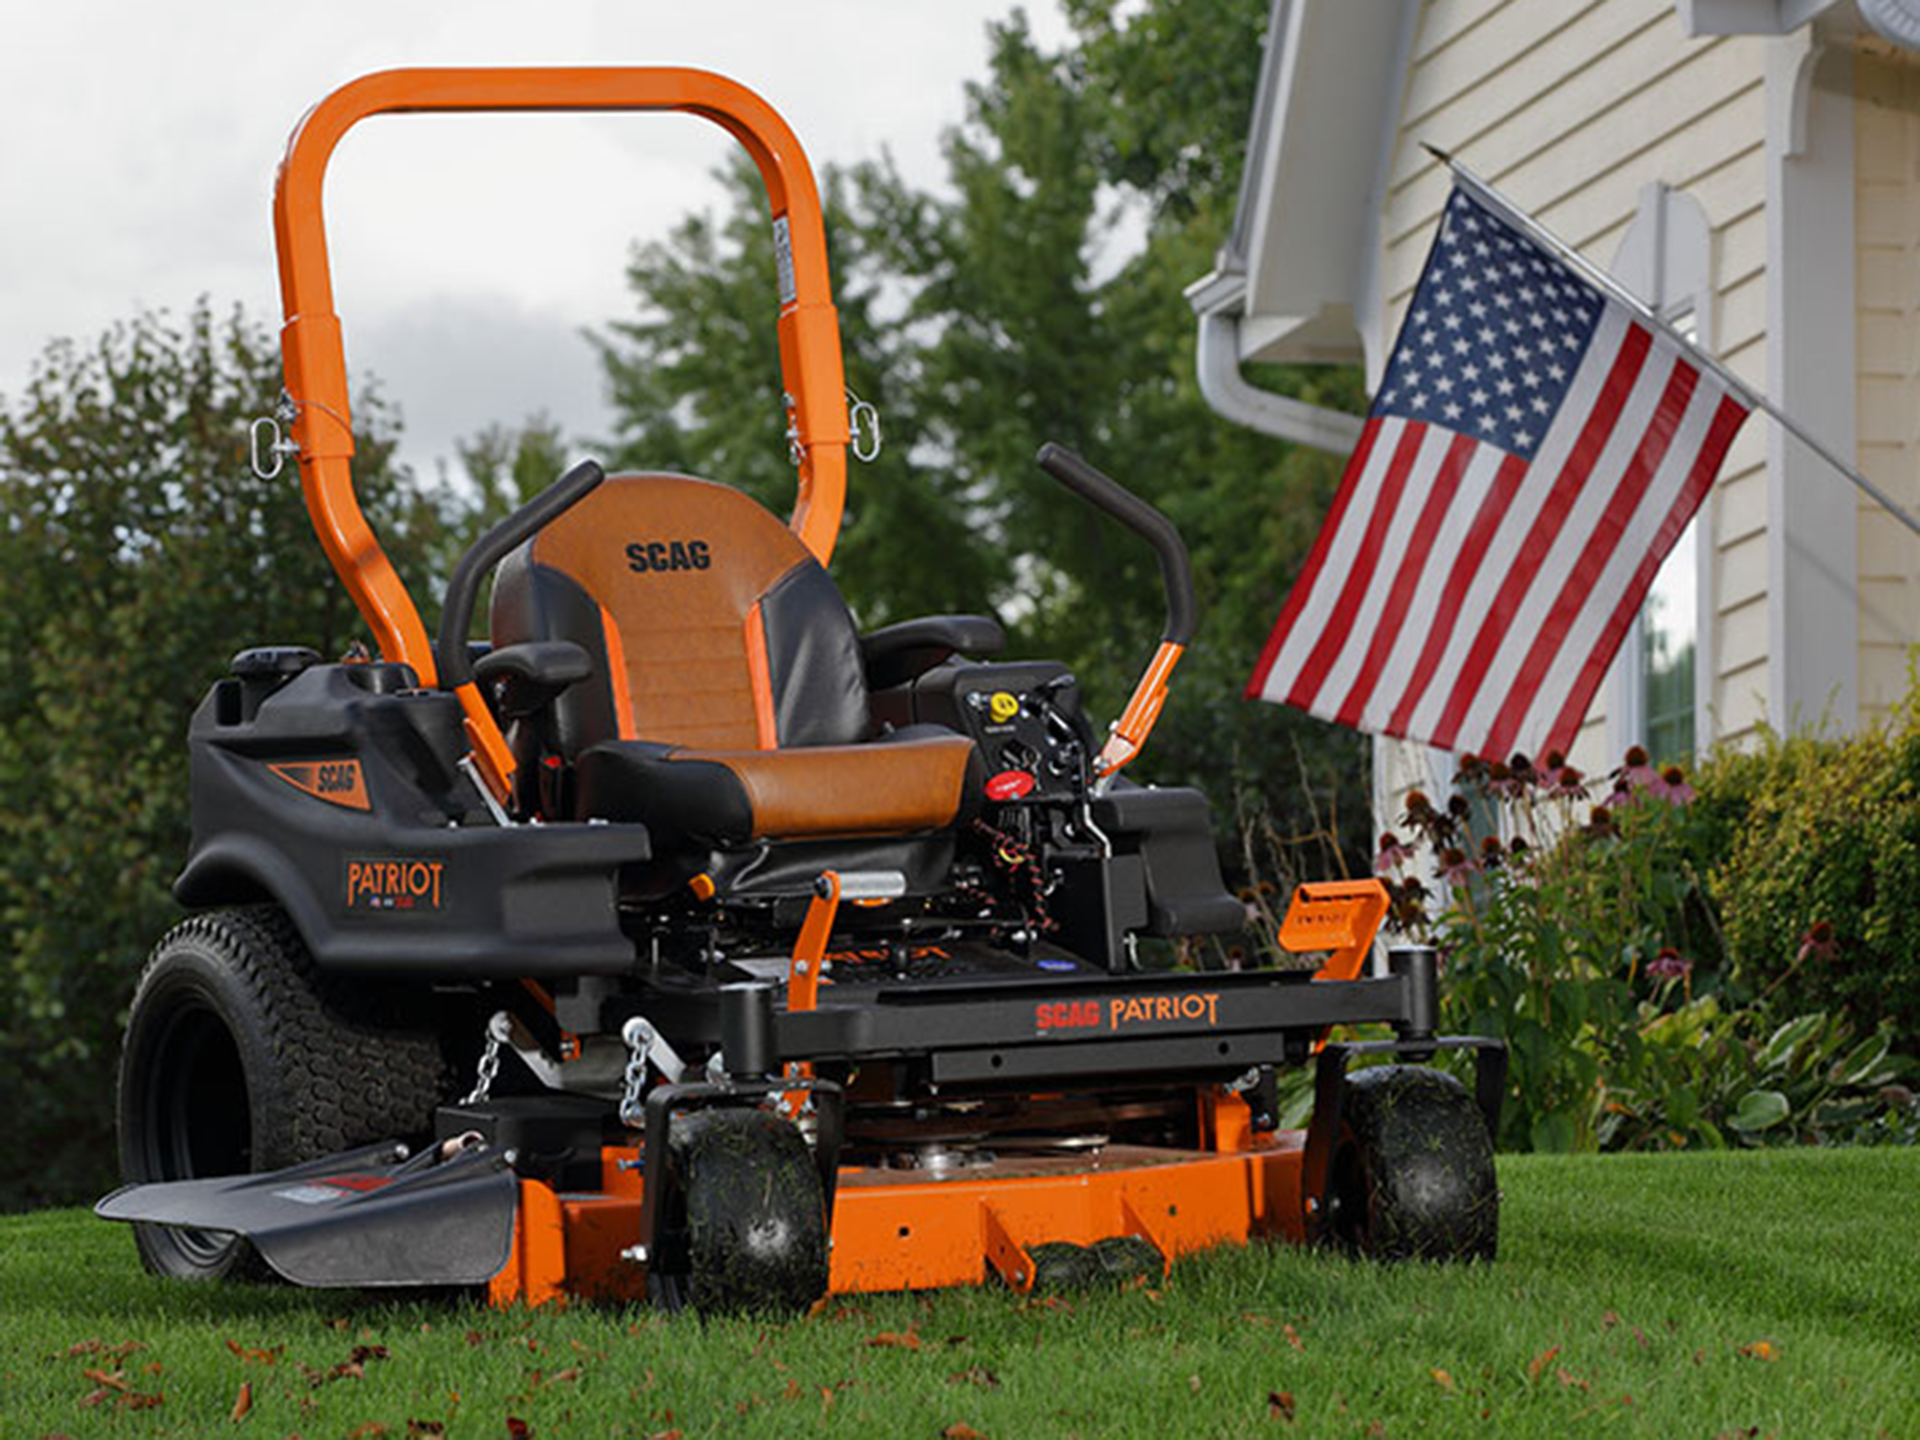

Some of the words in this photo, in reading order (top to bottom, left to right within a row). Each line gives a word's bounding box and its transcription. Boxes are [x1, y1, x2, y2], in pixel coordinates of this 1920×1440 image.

[625, 541, 710, 572] SCAG
[318, 764, 356, 792] SCAG
[347, 861, 443, 907] PATRIOT
[1036, 1001, 1100, 1029] SCAG
[1110, 993, 1219, 1031] PATRIOT
